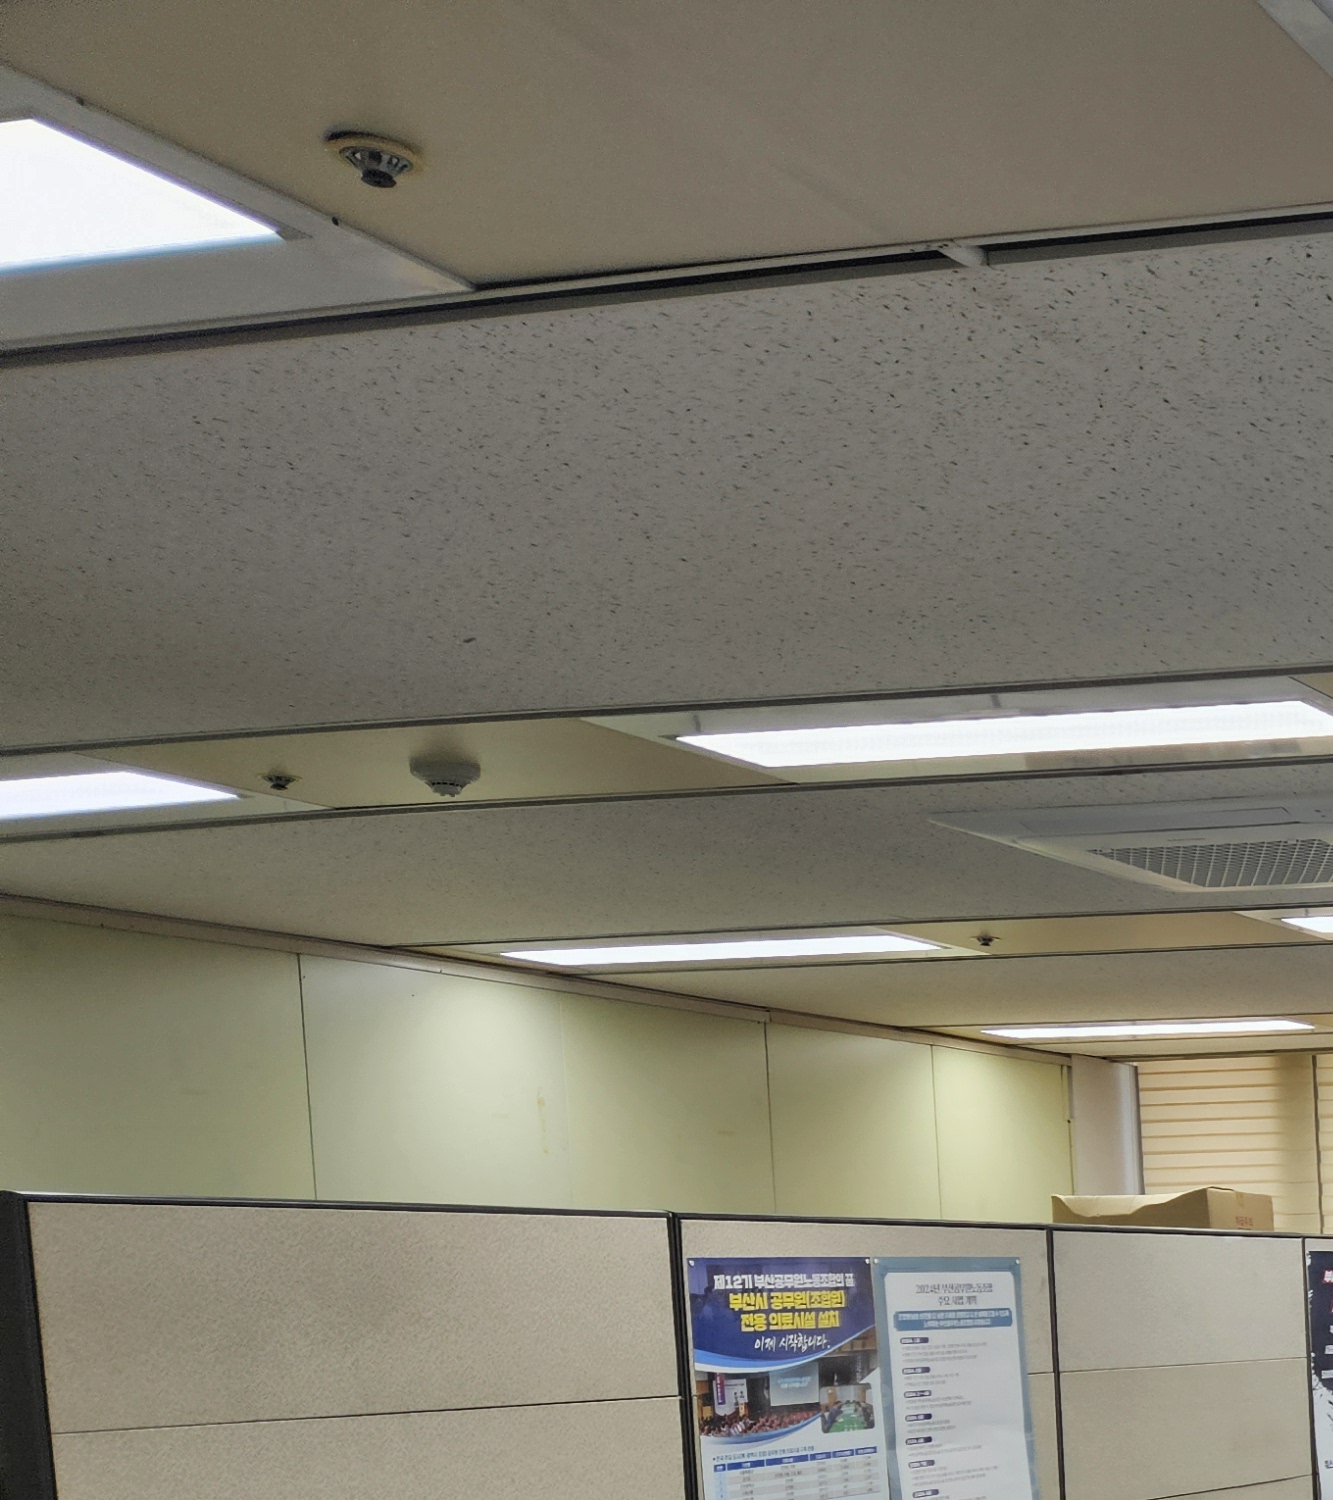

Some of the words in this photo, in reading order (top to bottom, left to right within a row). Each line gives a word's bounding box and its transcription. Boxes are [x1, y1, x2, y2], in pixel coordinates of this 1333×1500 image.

[714, 1274, 753, 1290] 제12기
[729, 1292, 768, 1312] 부산시
[770, 1290, 846, 1310] 공무원(조합원)
[741, 1313, 767, 1332] 전용
[769, 1311, 816, 1331] 의료시설
[818, 1310, 841, 1328] 설치
[754, 1335, 776, 1352] 이제
[778, 1332, 831, 1352] 시작합니다.
